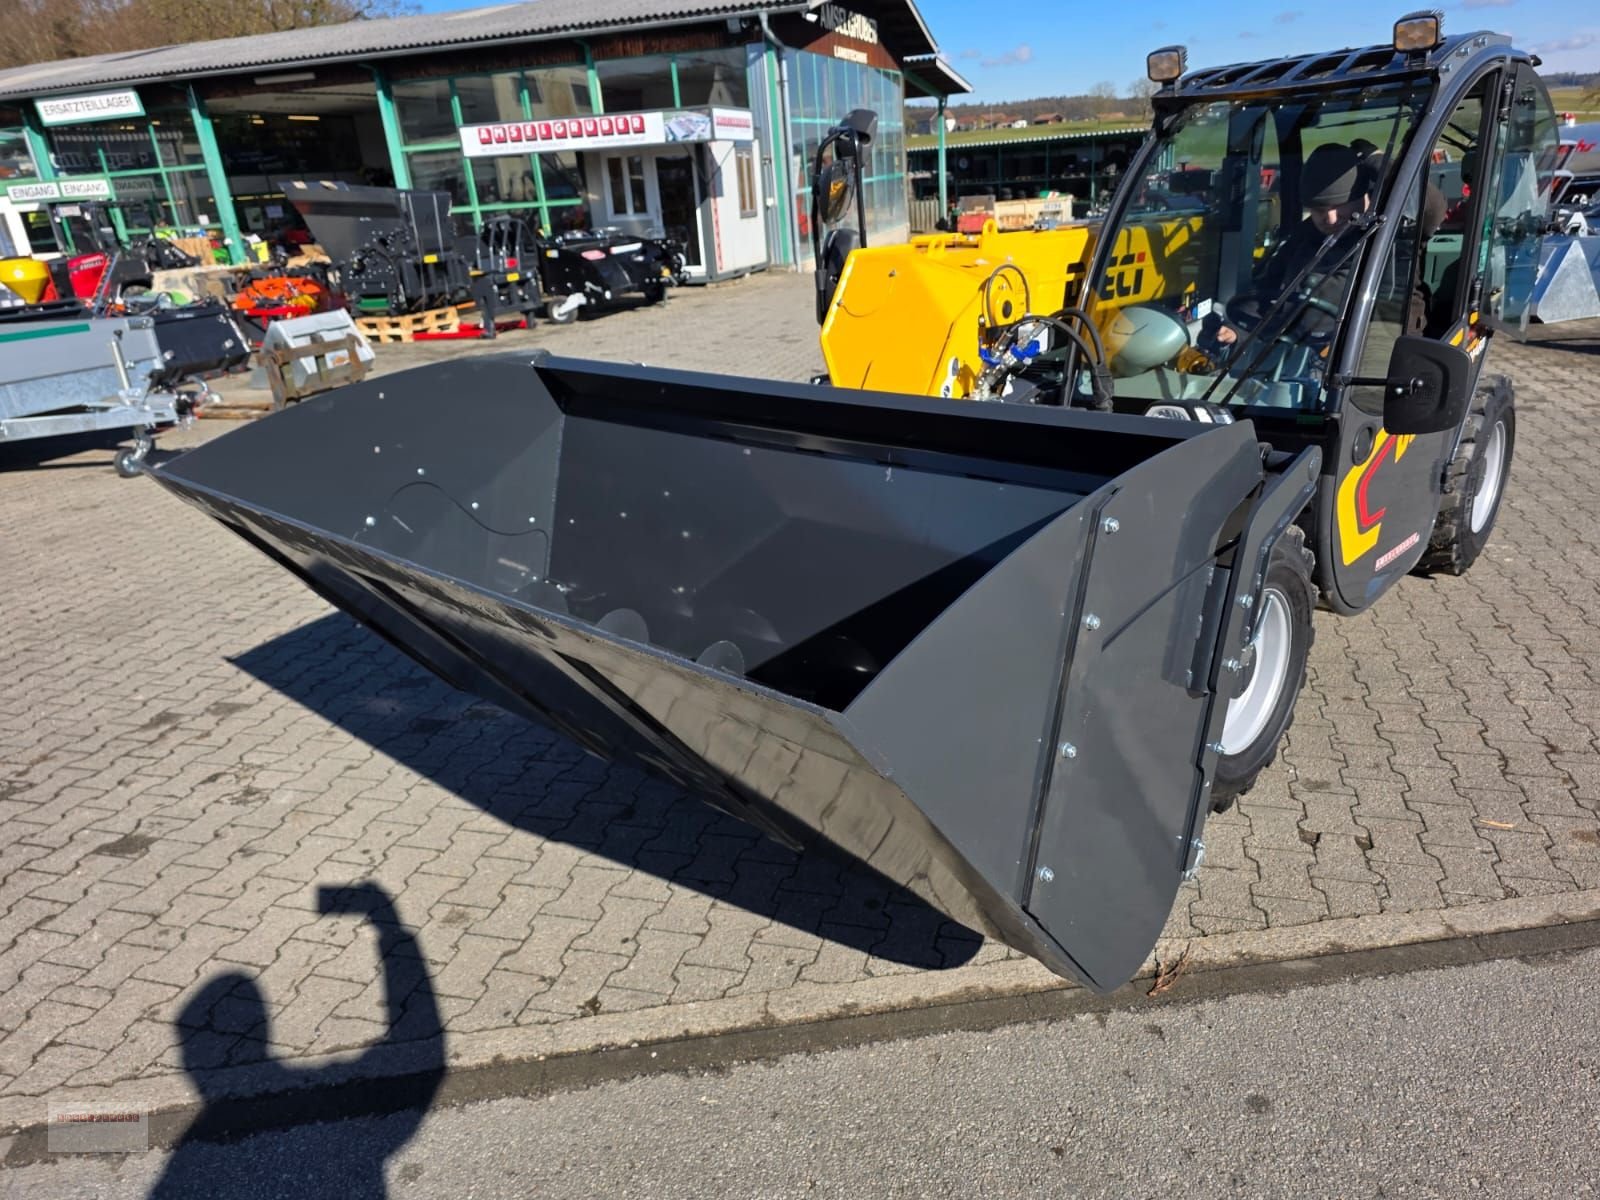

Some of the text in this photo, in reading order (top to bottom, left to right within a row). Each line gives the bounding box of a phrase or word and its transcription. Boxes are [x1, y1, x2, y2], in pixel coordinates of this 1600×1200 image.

[43, 95, 133, 117] ERSATZTEILLAGER
[478, 115, 645, 145] AMSELGRUBER
[12, 184, 55, 199] EINGANG
[63, 180, 106, 195] EINGANG
